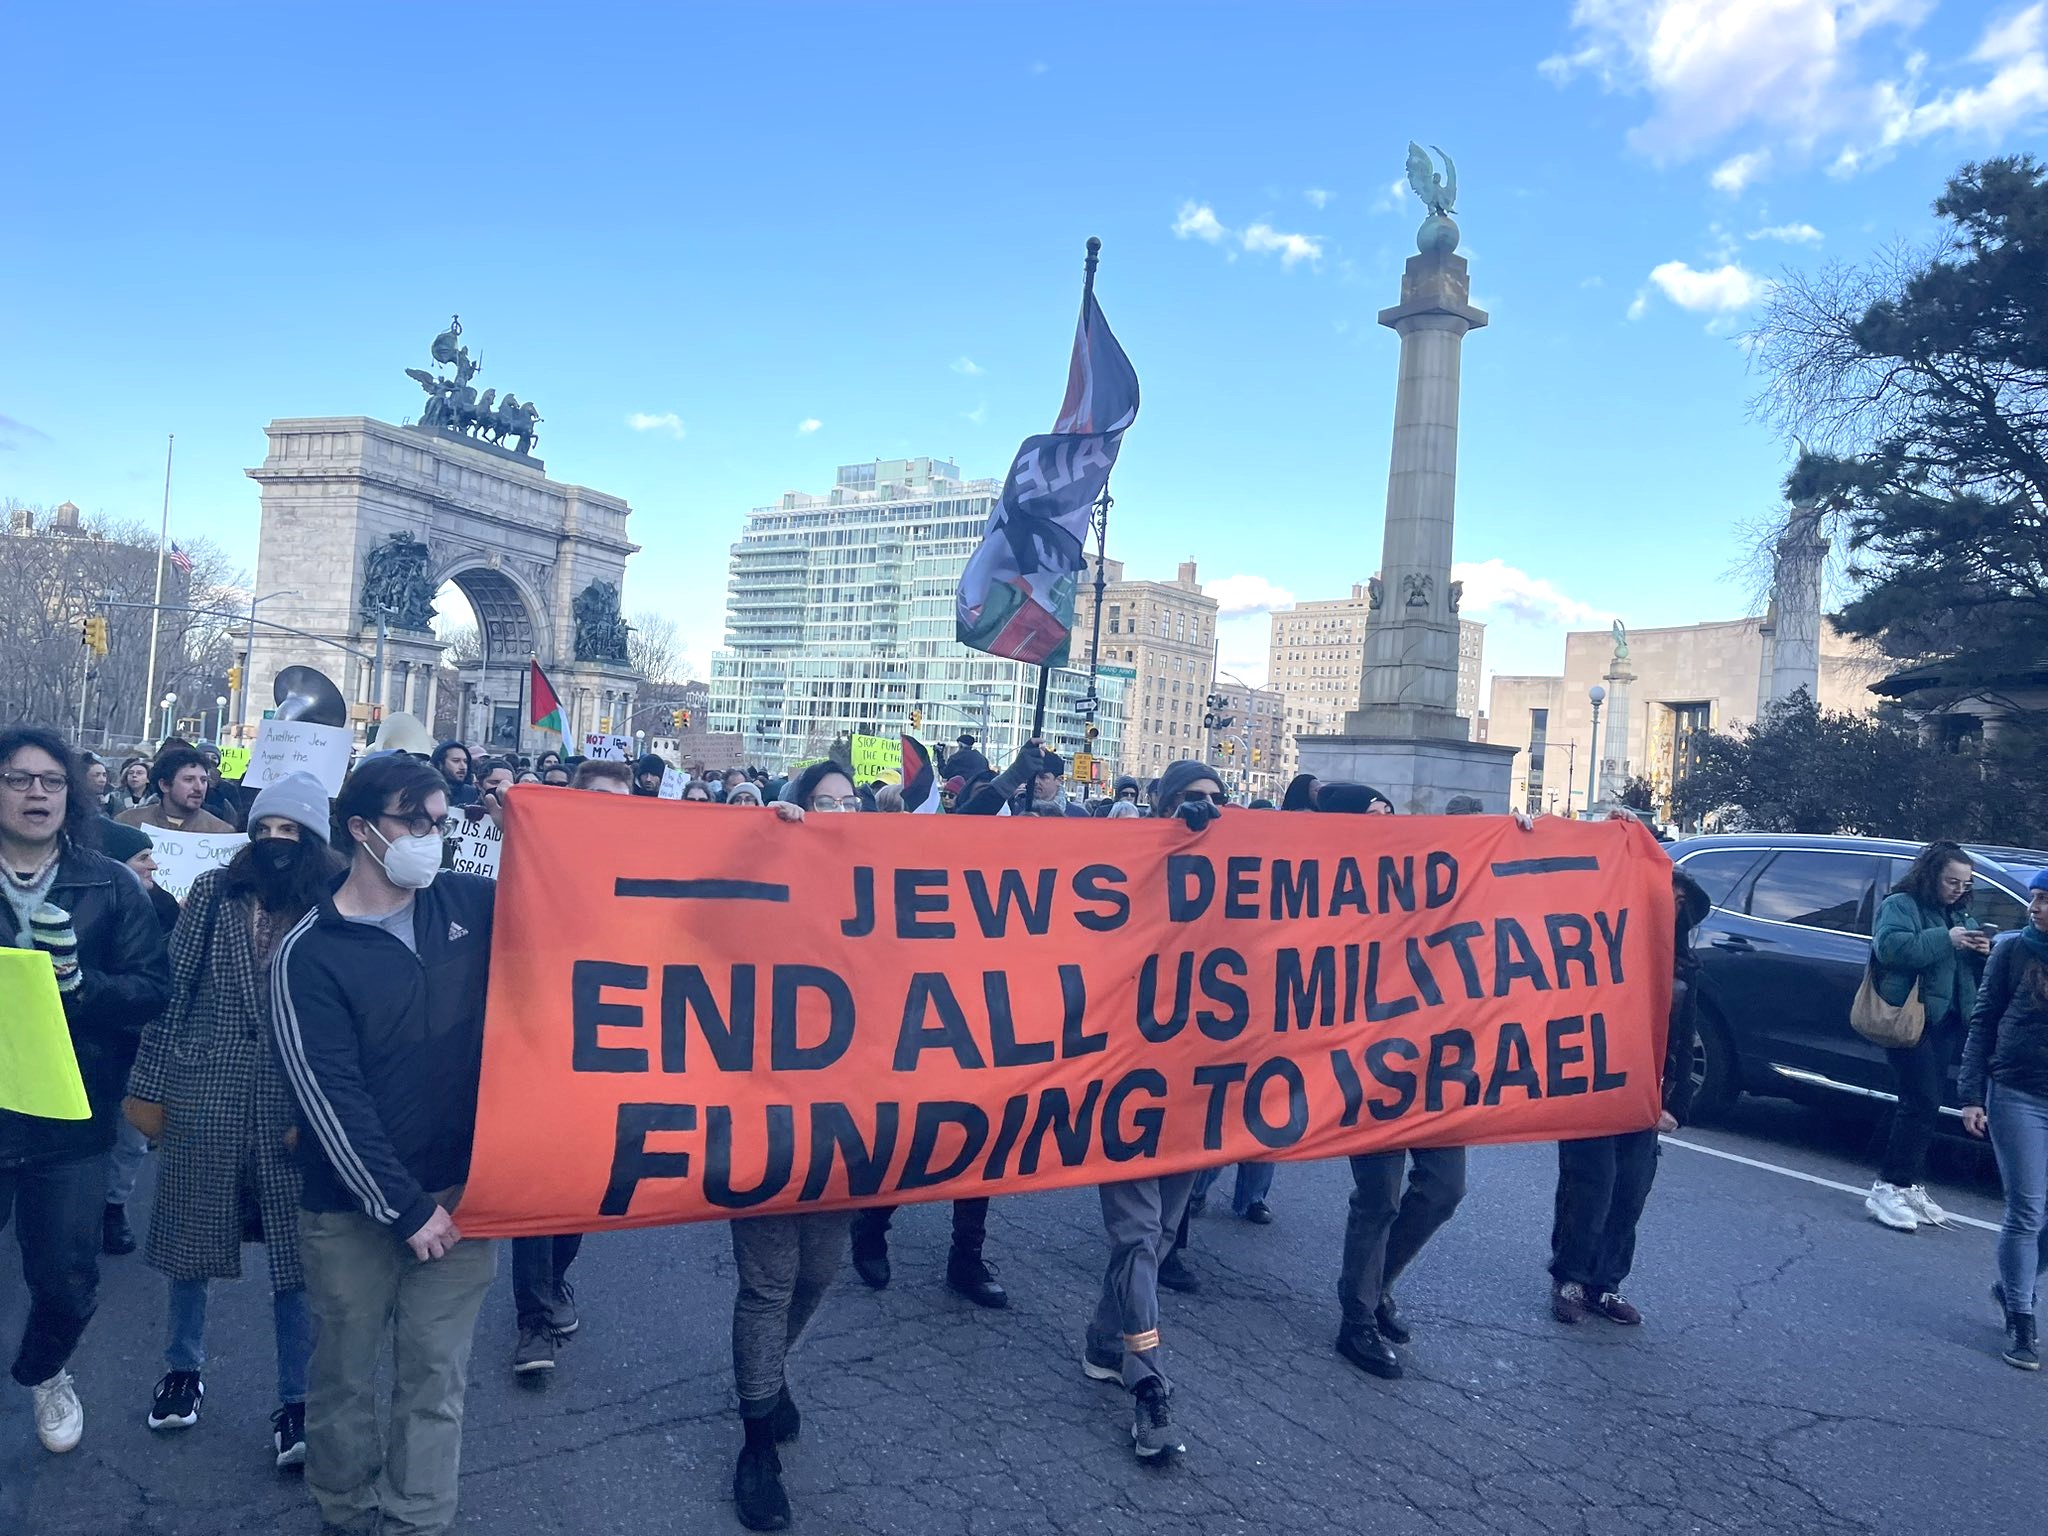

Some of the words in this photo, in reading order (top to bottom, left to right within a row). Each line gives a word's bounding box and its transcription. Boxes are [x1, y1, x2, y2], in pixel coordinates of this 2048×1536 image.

[264, 727, 300, 744] Another
[308, 732, 328, 747] Jew
[585, 734, 606, 745] NOT
[857, 736, 877, 748] STOP
[292, 752, 309, 762] the
[592, 746, 612, 758] MY
[862, 750, 878, 760] THE
[856, 763, 885, 777] CLEA
[461, 819, 481, 839] U.S.
[483, 825, 502, 842] AID
[473, 842, 488, 859] TO
[840, 863, 1130, 939] JEWS
[1166, 851, 1459, 923] DEMAND
[572, 959, 856, 1074] END
[892, 964, 1109, 1072] ALL
[1136, 946, 1250, 1044] US
[1273, 908, 1629, 1033] MILITARY
[597, 1068, 1168, 1217] FUNDING
[1193, 1055, 1309, 1150] TO
[1331, 1012, 1628, 1128] ISRAEL
